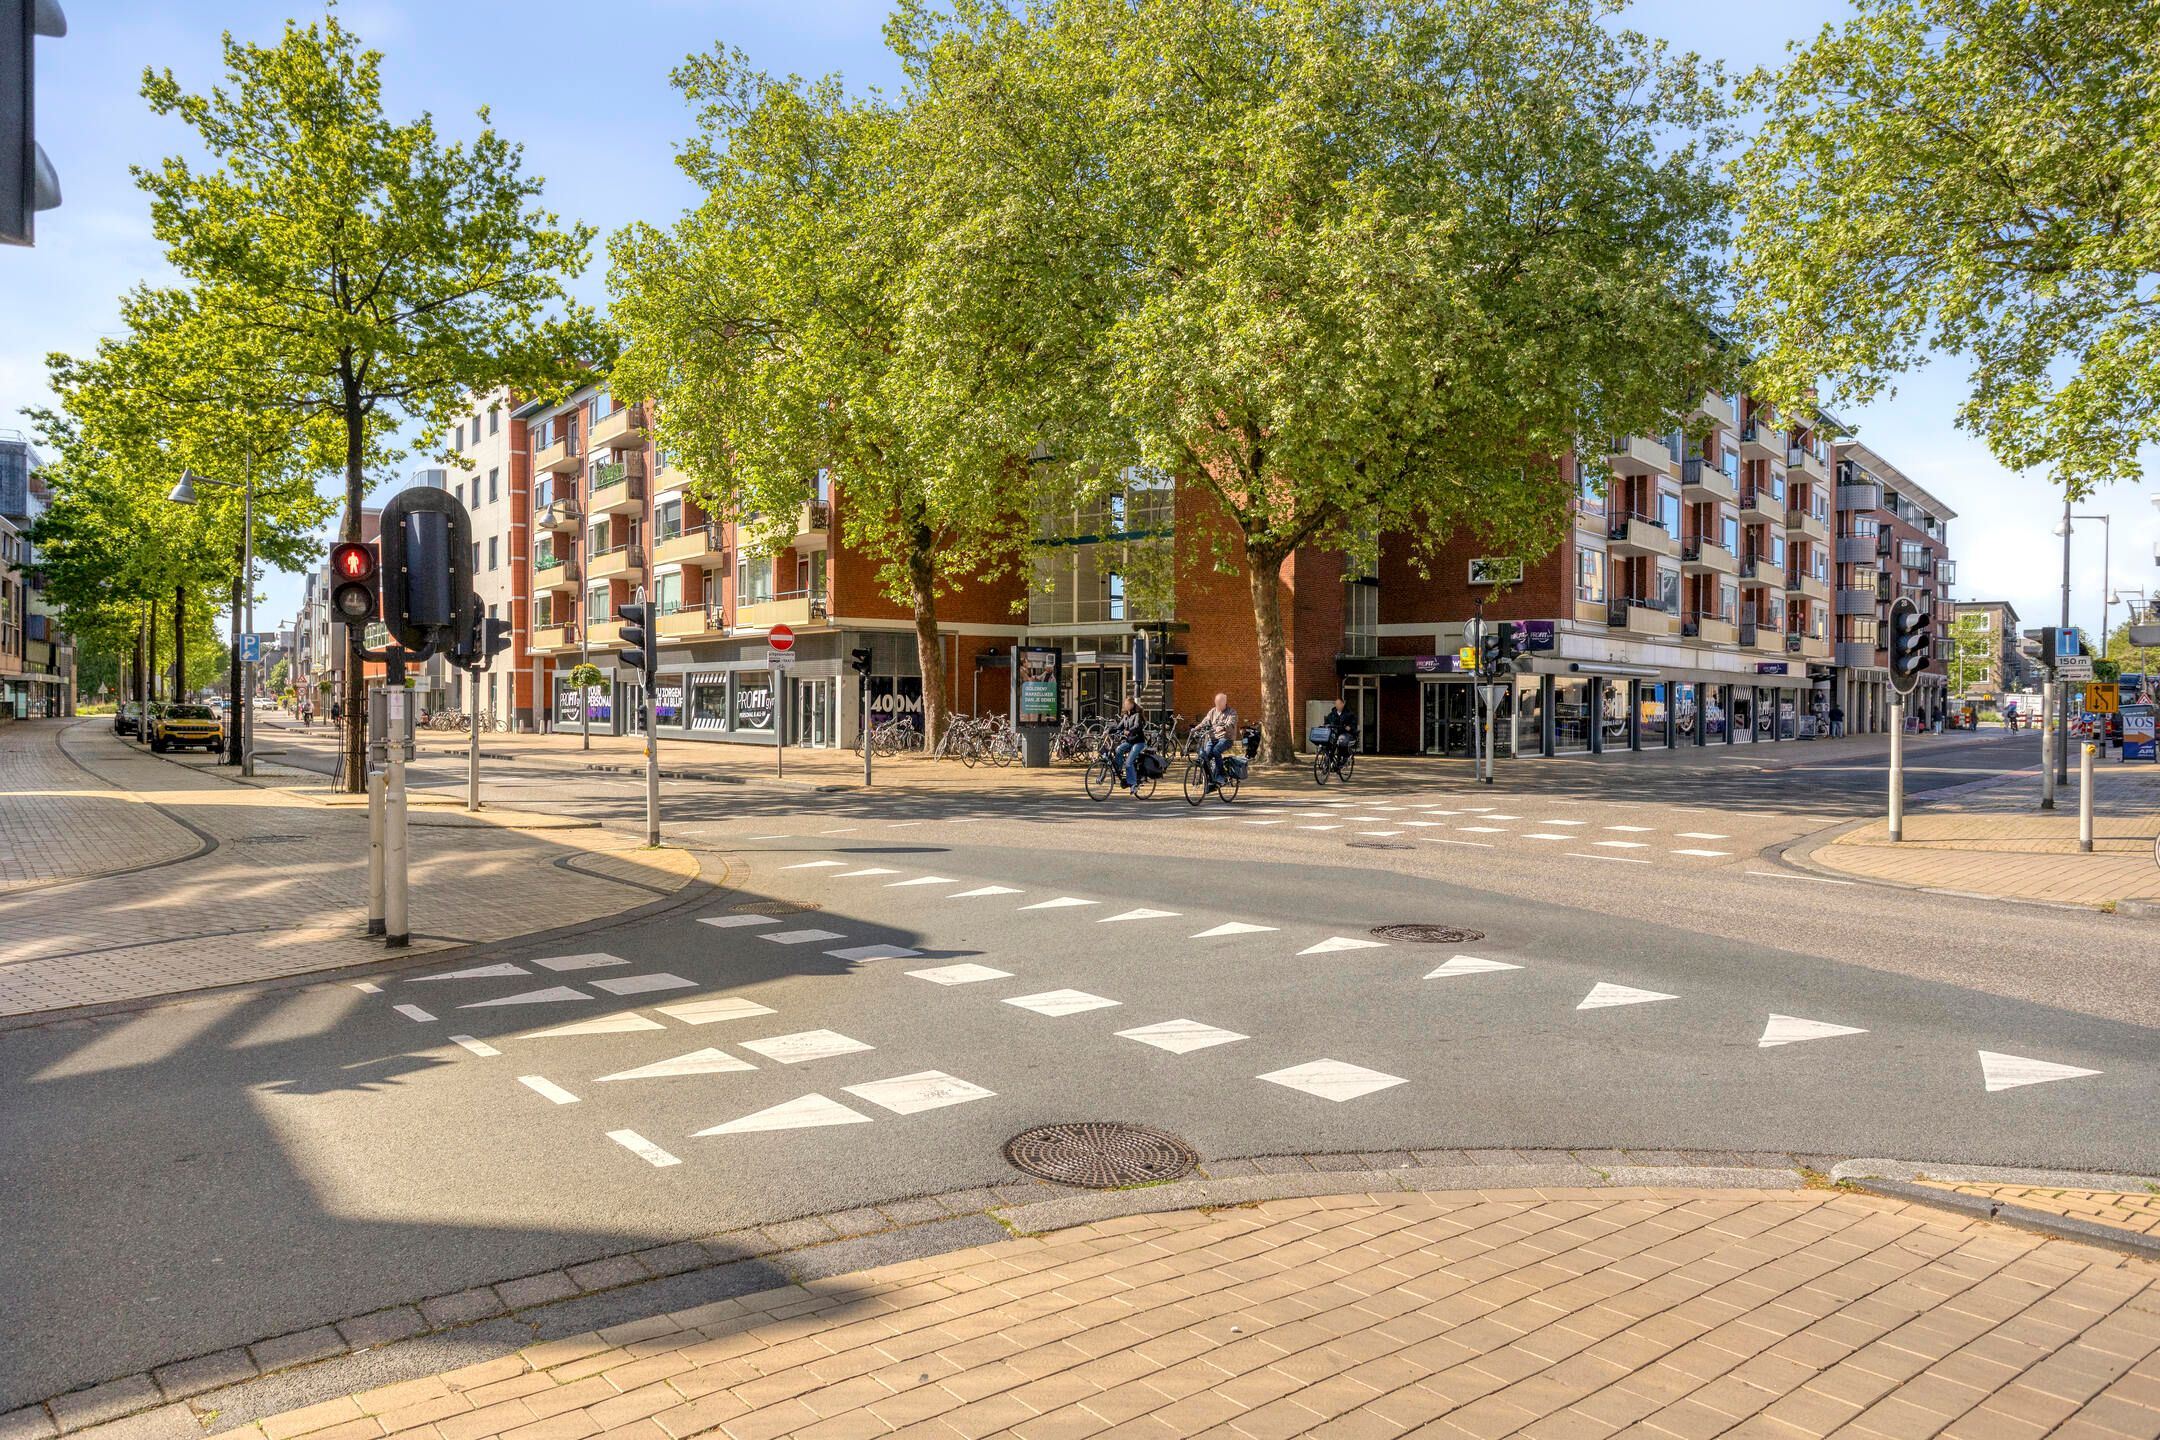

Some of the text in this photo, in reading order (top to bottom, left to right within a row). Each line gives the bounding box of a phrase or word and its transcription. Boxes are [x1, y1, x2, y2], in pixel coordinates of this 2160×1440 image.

[244, 636, 256, 650] P
[2059, 657, 2077, 665] 150
[736, 689, 768, 709] PROFIT
[2126, 717, 2154, 728] VOS
